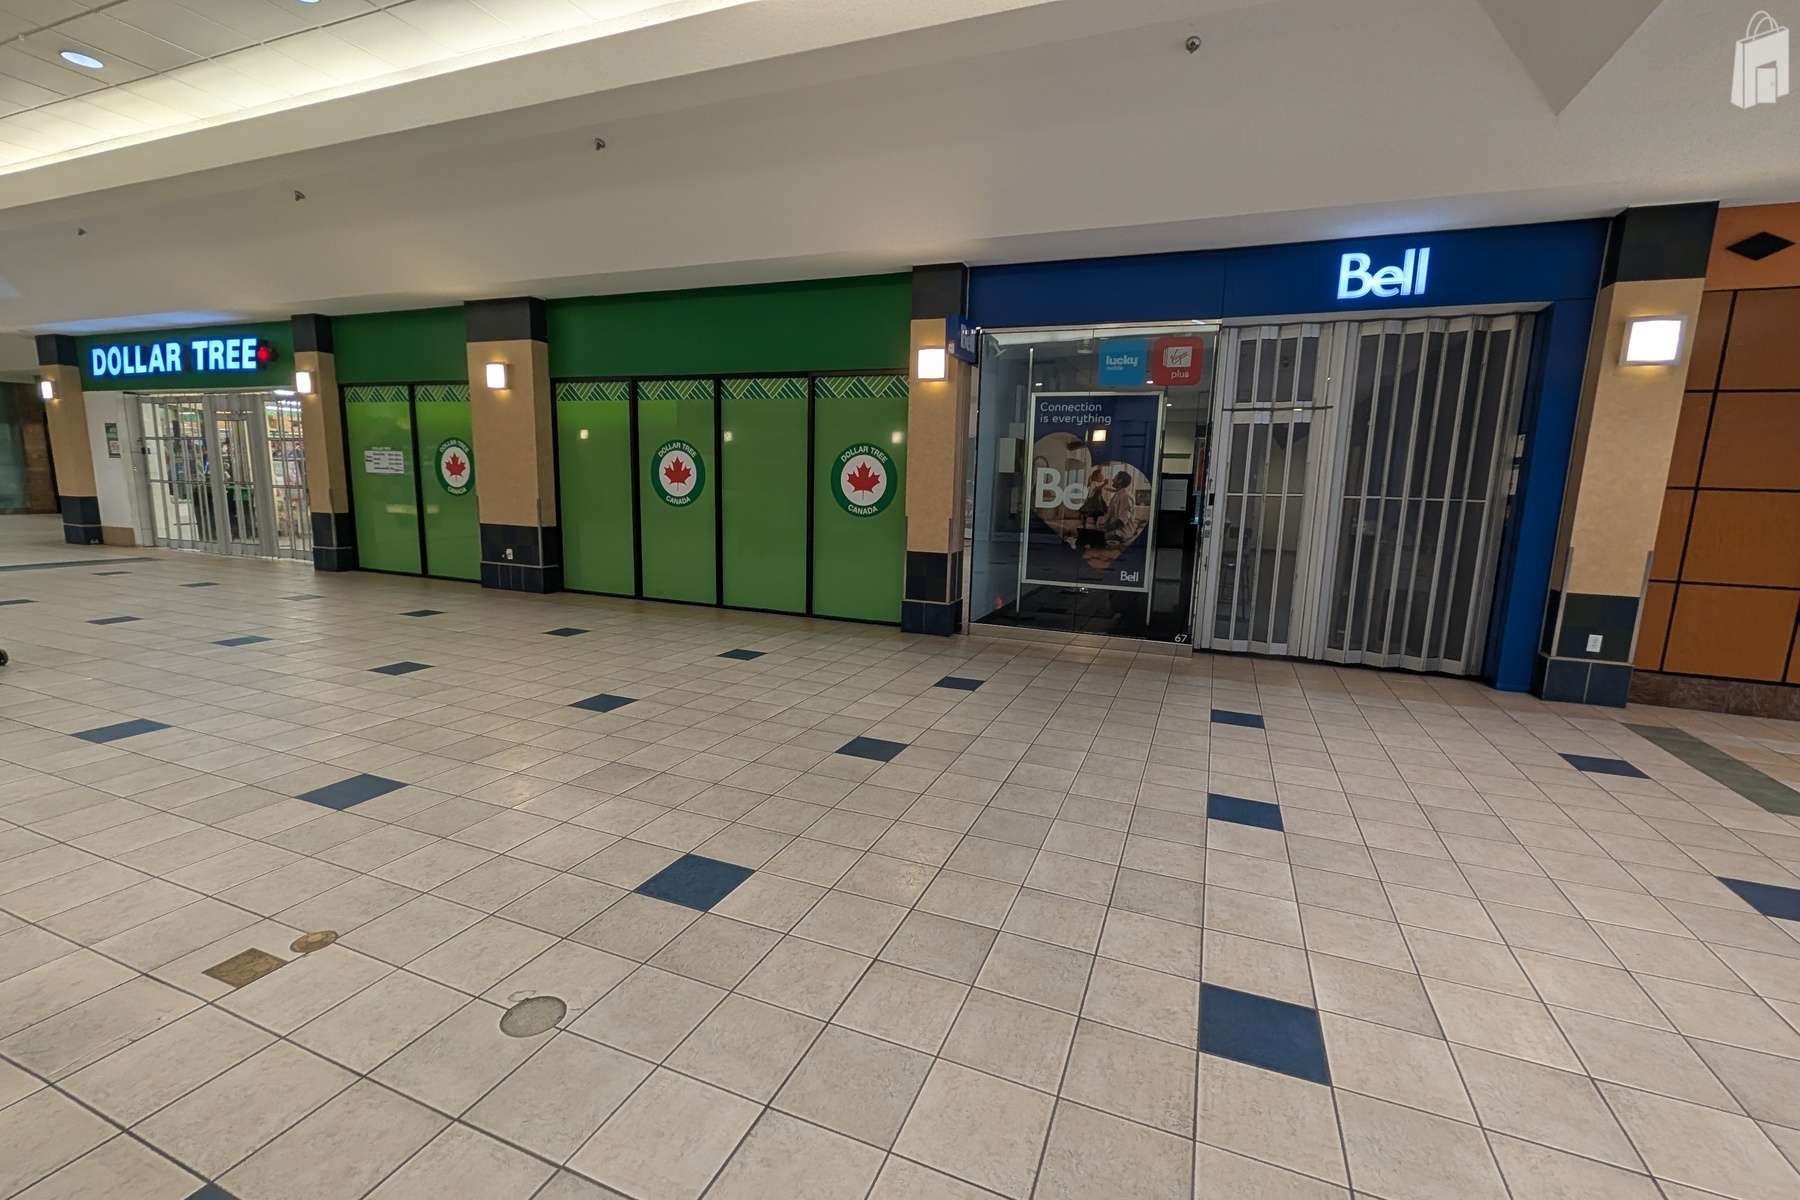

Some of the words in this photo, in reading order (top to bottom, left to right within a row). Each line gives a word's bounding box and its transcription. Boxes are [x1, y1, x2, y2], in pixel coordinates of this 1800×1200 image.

[1337, 247, 1430, 300] Bell
[92, 343, 182, 376] DOLLAR
[192, 339, 257, 370] TREE
[1105, 354, 1138, 367] lucky
[1170, 349, 1189, 365] Virgin
[1171, 370, 1189, 380] plus
[1040, 402, 1102, 412] Connection
[1040, 414, 1049, 424] is
[1052, 413, 1112, 426] everything
[440, 440, 457, 452] DOLLAR
[457, 440, 470, 453] TREE
[658, 442, 681, 457] DOLLAR
[682, 443, 697, 458] TREE
[841, 445, 869, 462] DOLLAR
[870, 447, 888, 464] TREE
[447, 486, 467, 495] CANADA
[666, 495, 691, 505] CANADA
[848, 504, 878, 515] CANADA
[1120, 570, 1139, 582] Bell
[1174, 633, 1188, 644] 67
